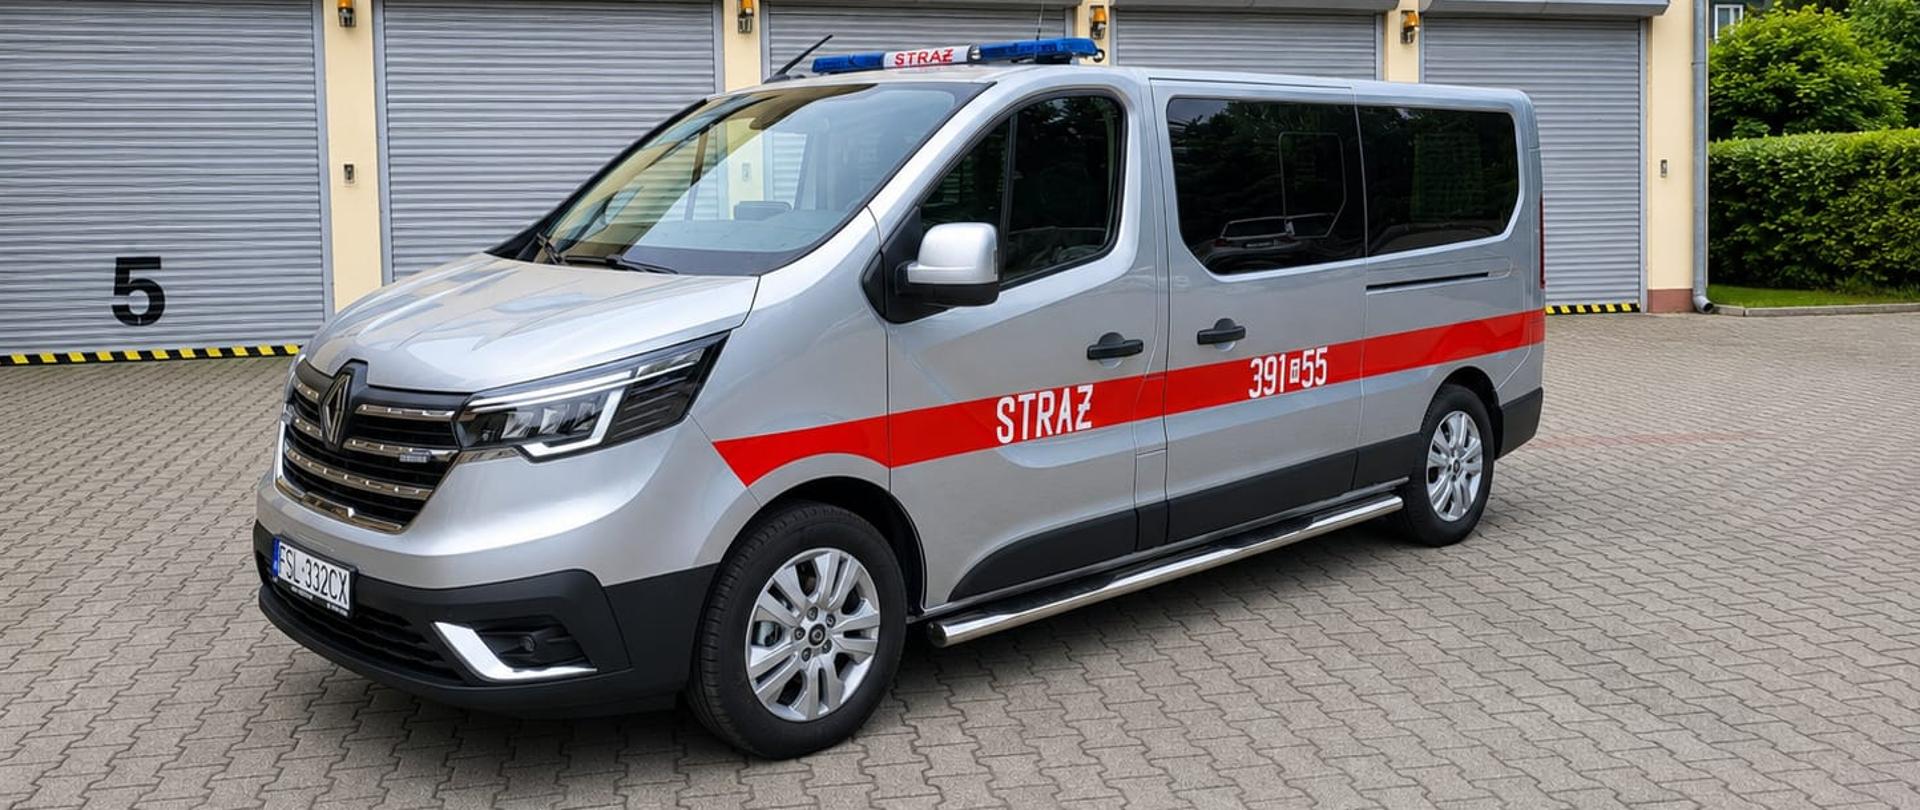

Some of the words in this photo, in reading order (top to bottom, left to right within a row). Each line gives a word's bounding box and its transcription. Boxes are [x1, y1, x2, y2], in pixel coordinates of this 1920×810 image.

[111, 256, 166, 327] 5
[1248, 353, 1287, 398] 391
[1301, 346, 1328, 388] 55
